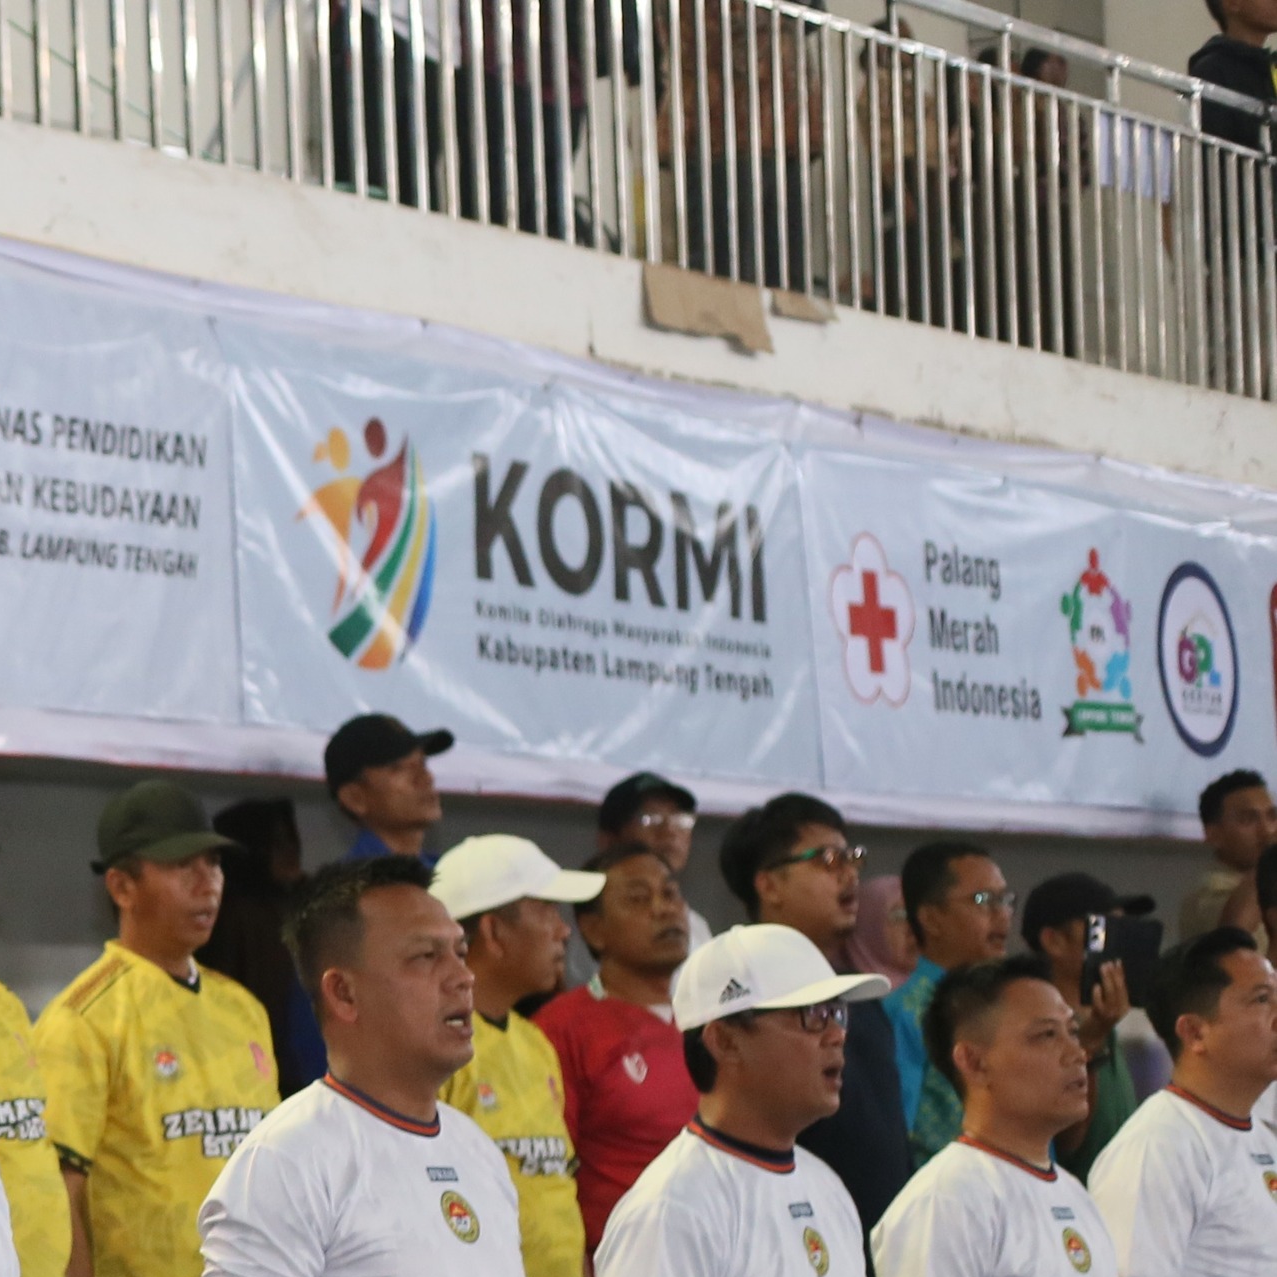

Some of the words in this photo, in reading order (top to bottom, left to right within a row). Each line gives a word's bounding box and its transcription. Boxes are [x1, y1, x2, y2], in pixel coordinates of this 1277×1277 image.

[50, 413, 207, 469] PENDIDIKAN
[31, 473, 202, 531] KEBUDAYAAN
[20, 531, 118, 571] LAMPUNG
[123, 543, 199, 580] TENGAH
[470, 448, 769, 625] KORMI
[923, 538, 1003, 602] Palang
[928, 605, 1000, 656] Merah
[475, 630, 597, 676] Kabupaten
[602, 650, 699, 695] Lampung
[704, 663, 775, 702] Tengah
[931, 666, 1043, 721] Indonesia
